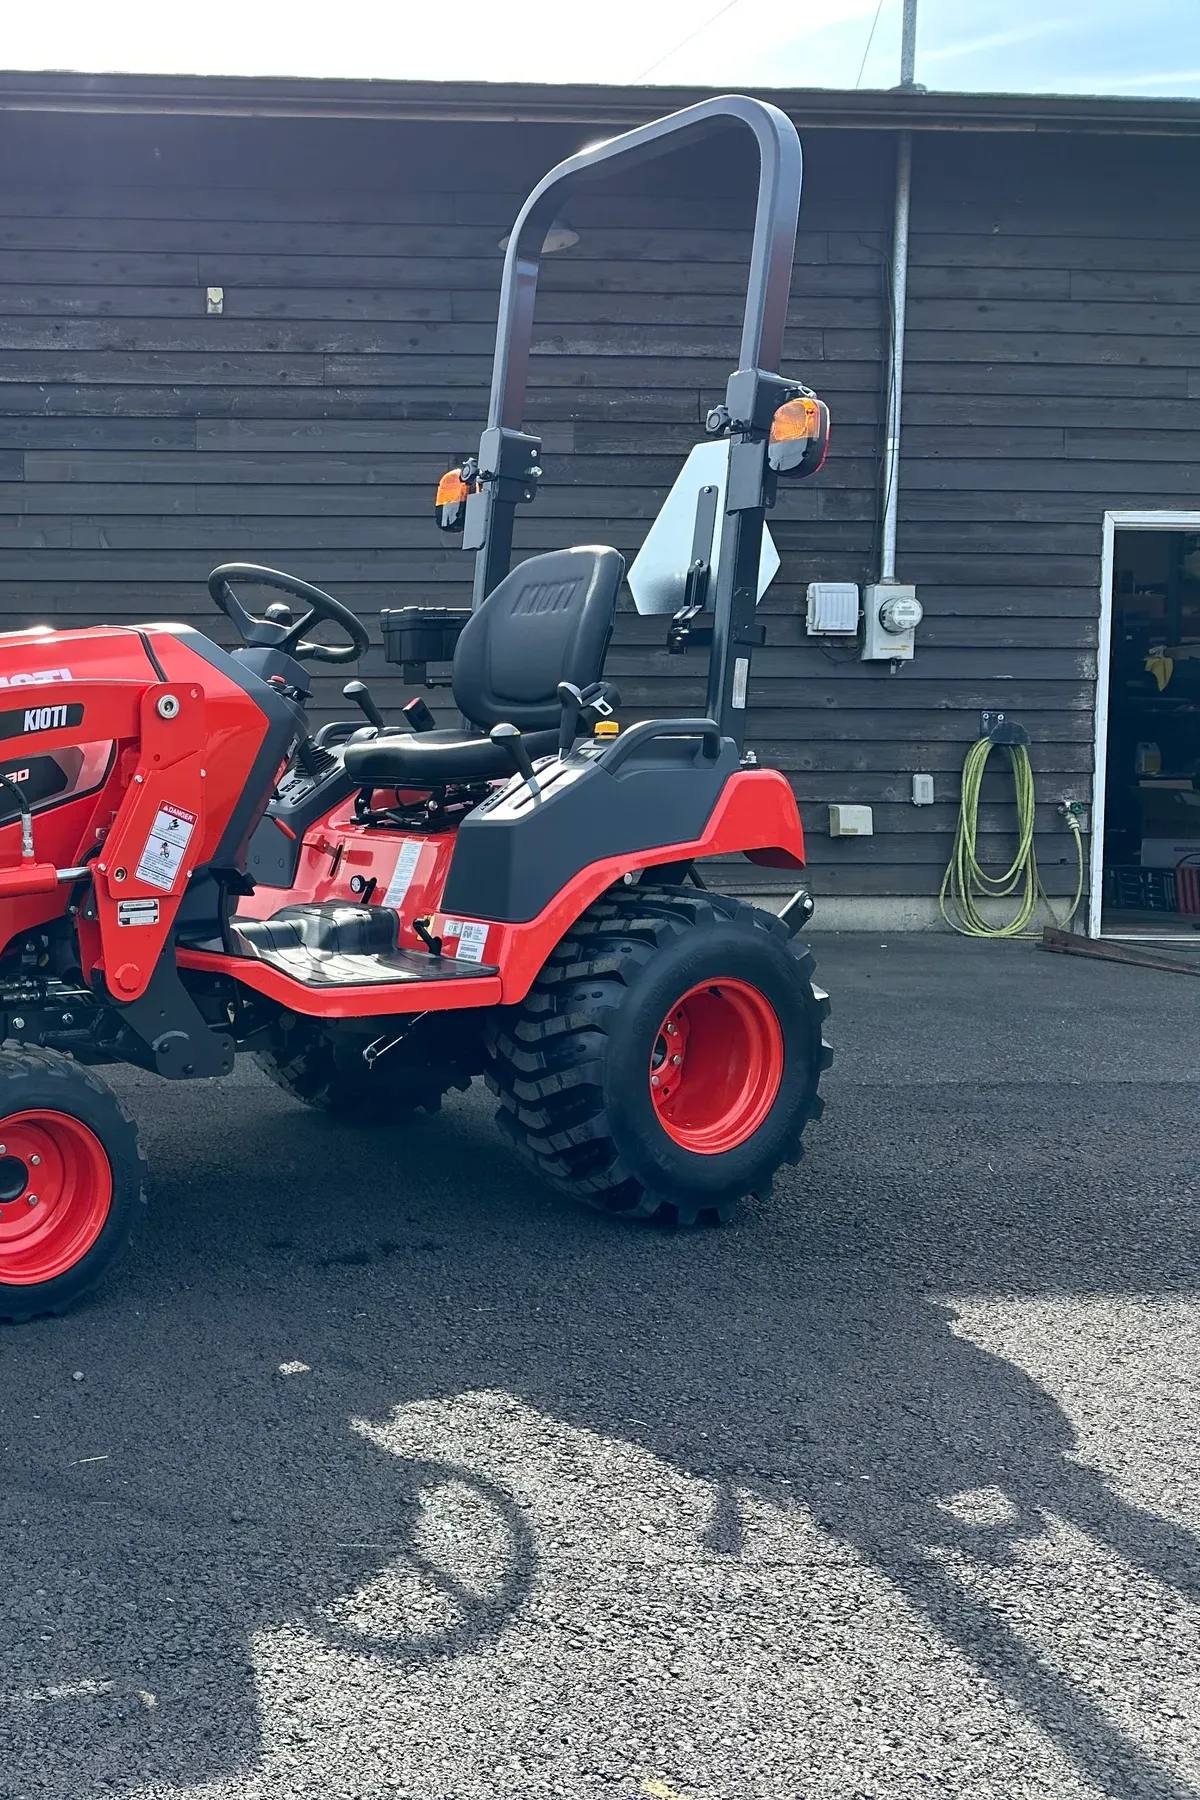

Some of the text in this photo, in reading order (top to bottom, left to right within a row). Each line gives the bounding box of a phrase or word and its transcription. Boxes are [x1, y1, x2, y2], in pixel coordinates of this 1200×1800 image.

[510, 576, 584, 616] KIOTI
[24, 705, 67, 732] KIOTI
[167, 805, 194, 822] DANGER
